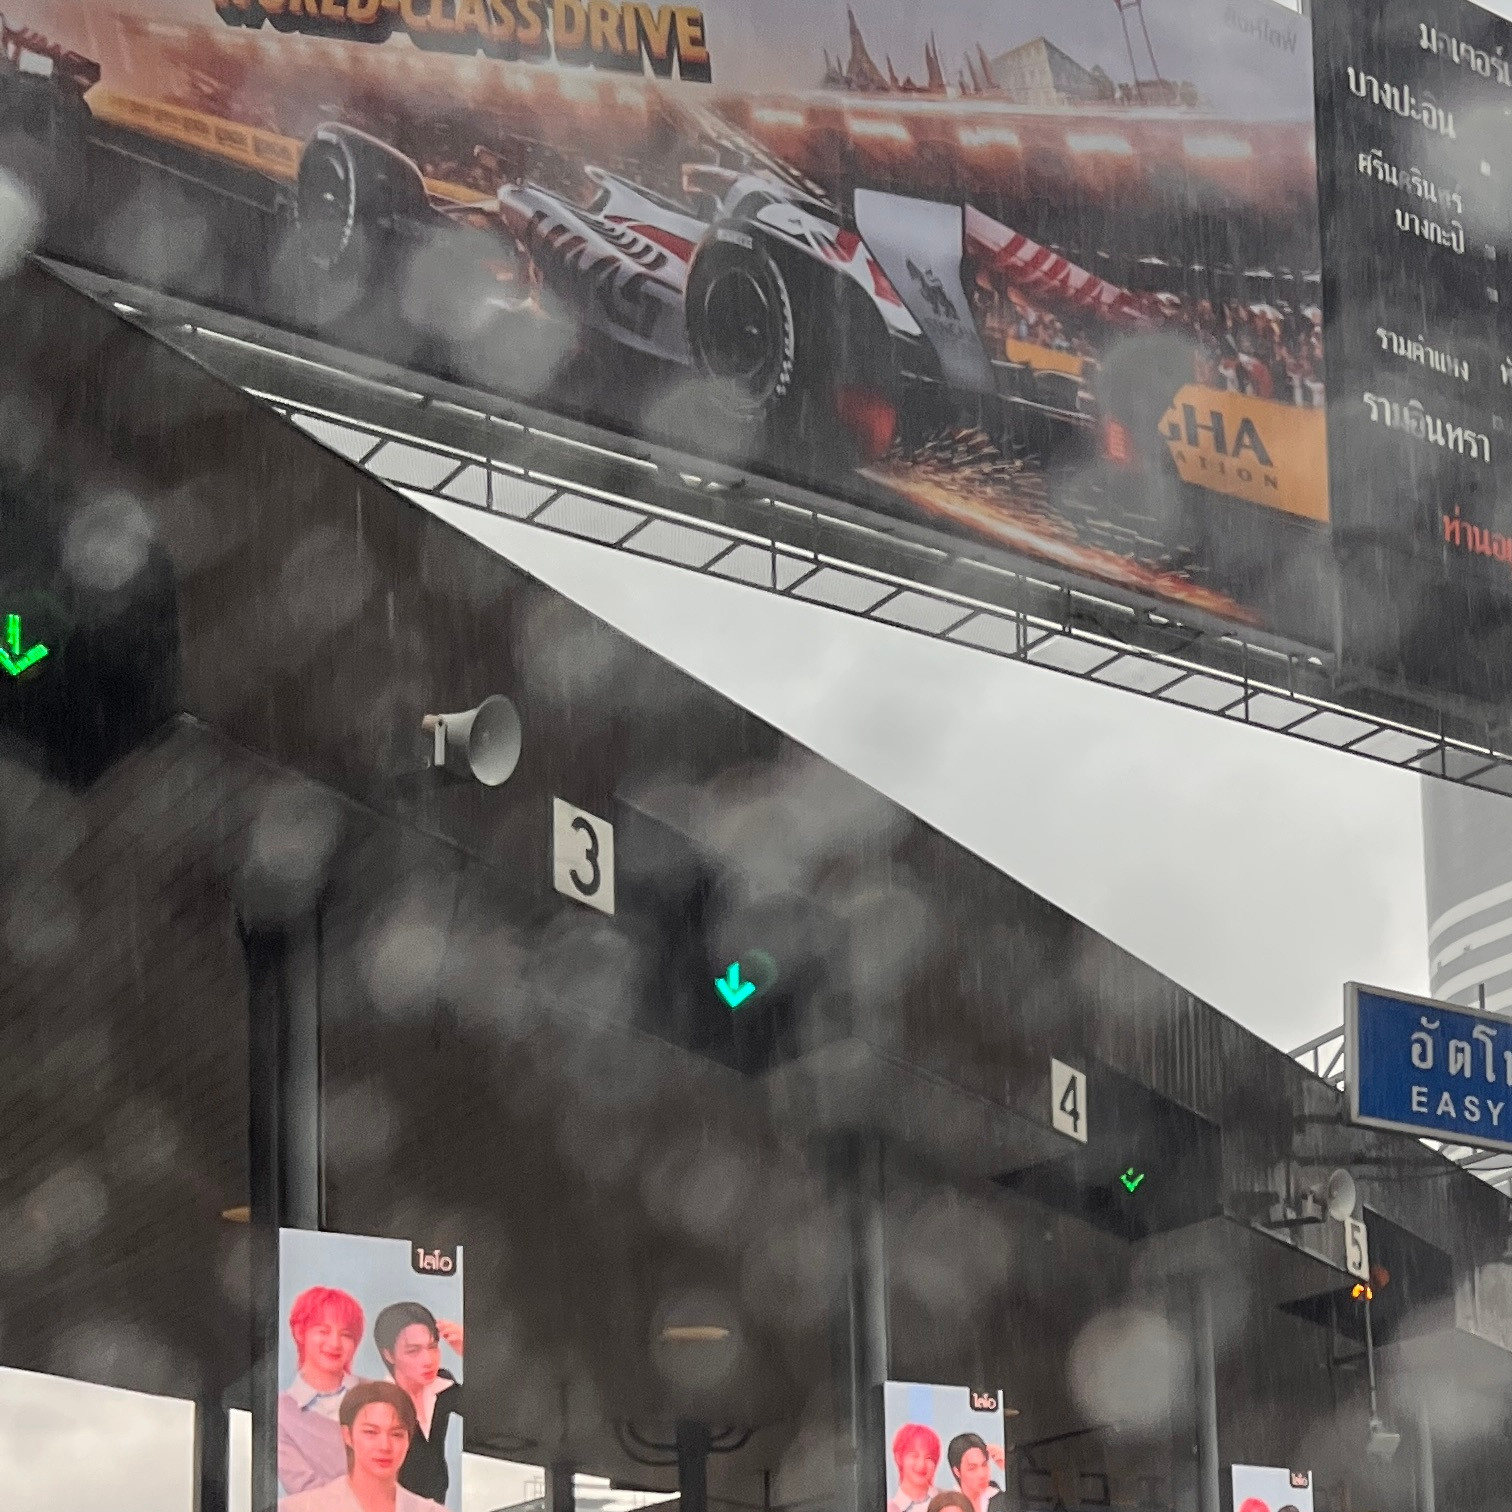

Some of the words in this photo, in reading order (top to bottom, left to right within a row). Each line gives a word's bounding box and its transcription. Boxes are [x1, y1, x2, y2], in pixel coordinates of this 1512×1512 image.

[551, 0, 708, 63] DRIVE
[1395, 208, 1465, 255] บางกะปิ
[568, 816, 602, 897] 3
[1059, 1074, 1082, 1134] 4
[1410, 1085, 1505, 1126] EASY
[1350, 1223, 1364, 1272] 5
